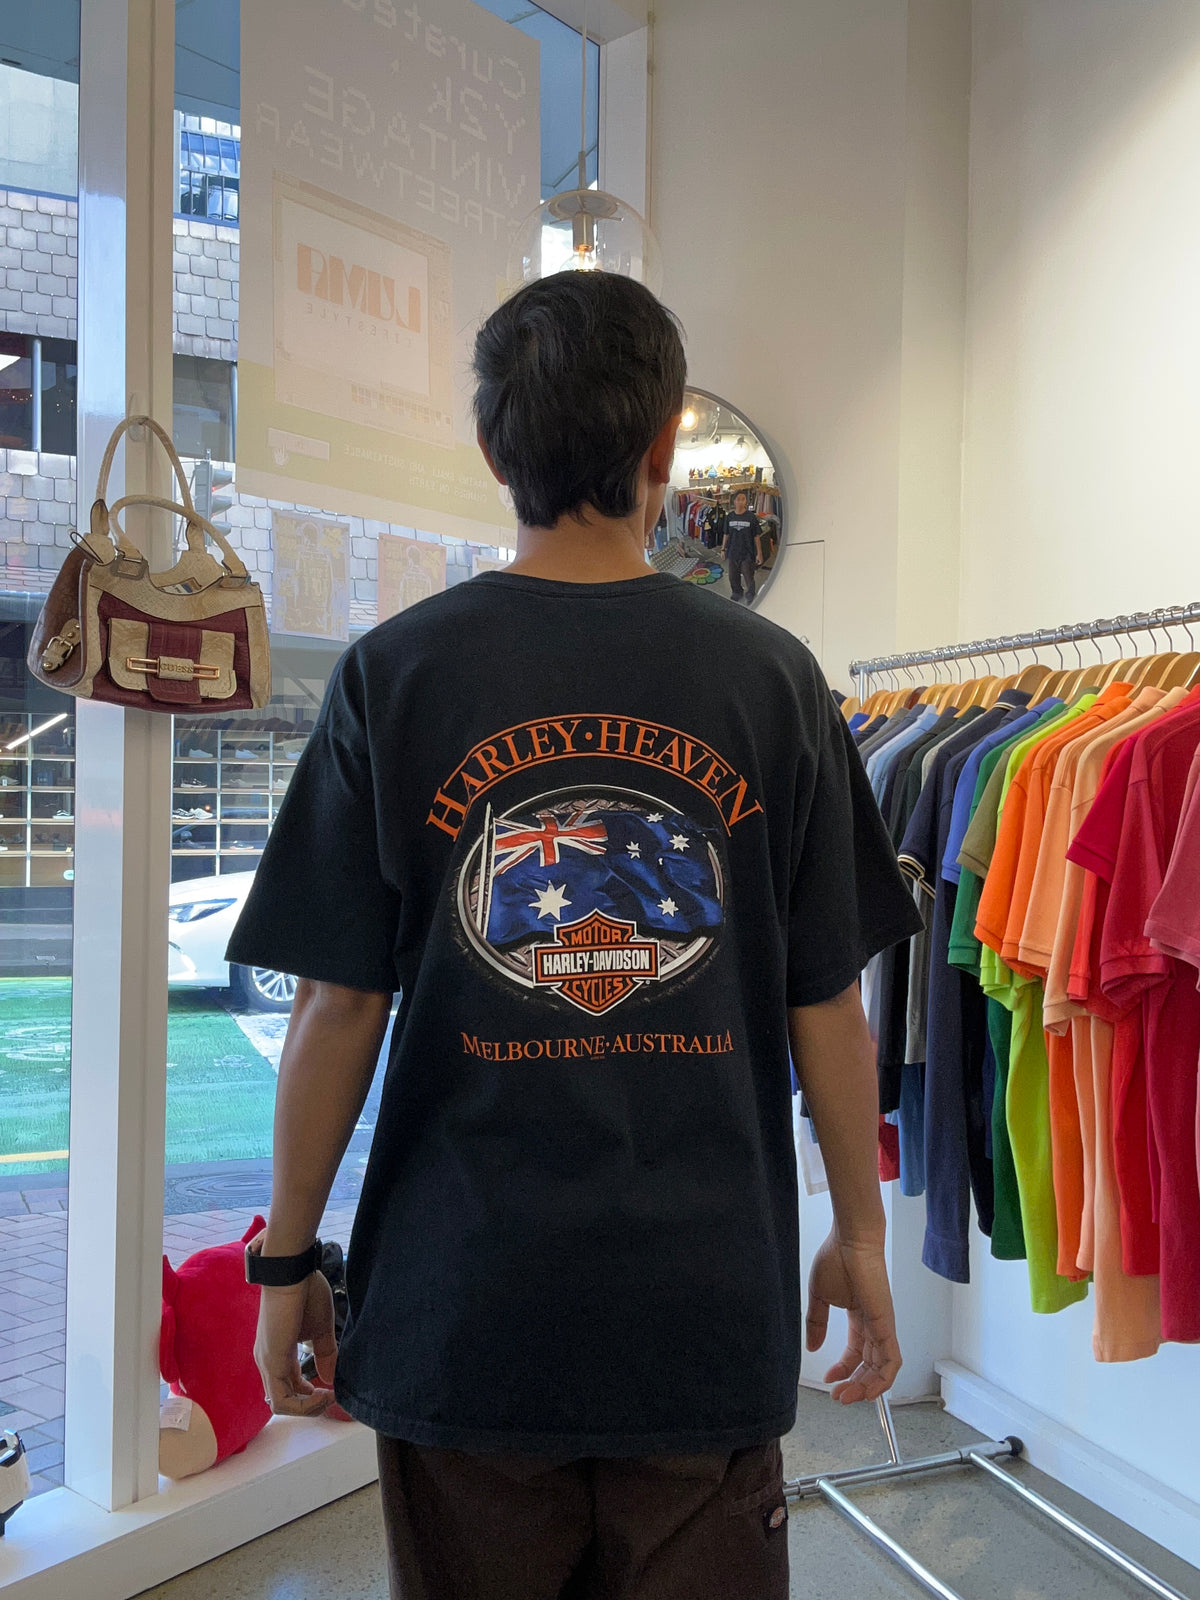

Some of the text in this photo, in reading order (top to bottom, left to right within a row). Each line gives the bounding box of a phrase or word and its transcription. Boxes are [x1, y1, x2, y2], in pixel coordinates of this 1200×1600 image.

[160, 662, 193, 674] GUESS
[426, 717, 765, 842] HARLEY HEAVEN
[571, 924, 621, 944] MOTOR
[543, 948, 650, 975] HARLEY-DAVIDSON
[572, 978, 623, 1007] CYCLES
[462, 1029, 734, 1062] MELBOURNE AUSTRALIA
